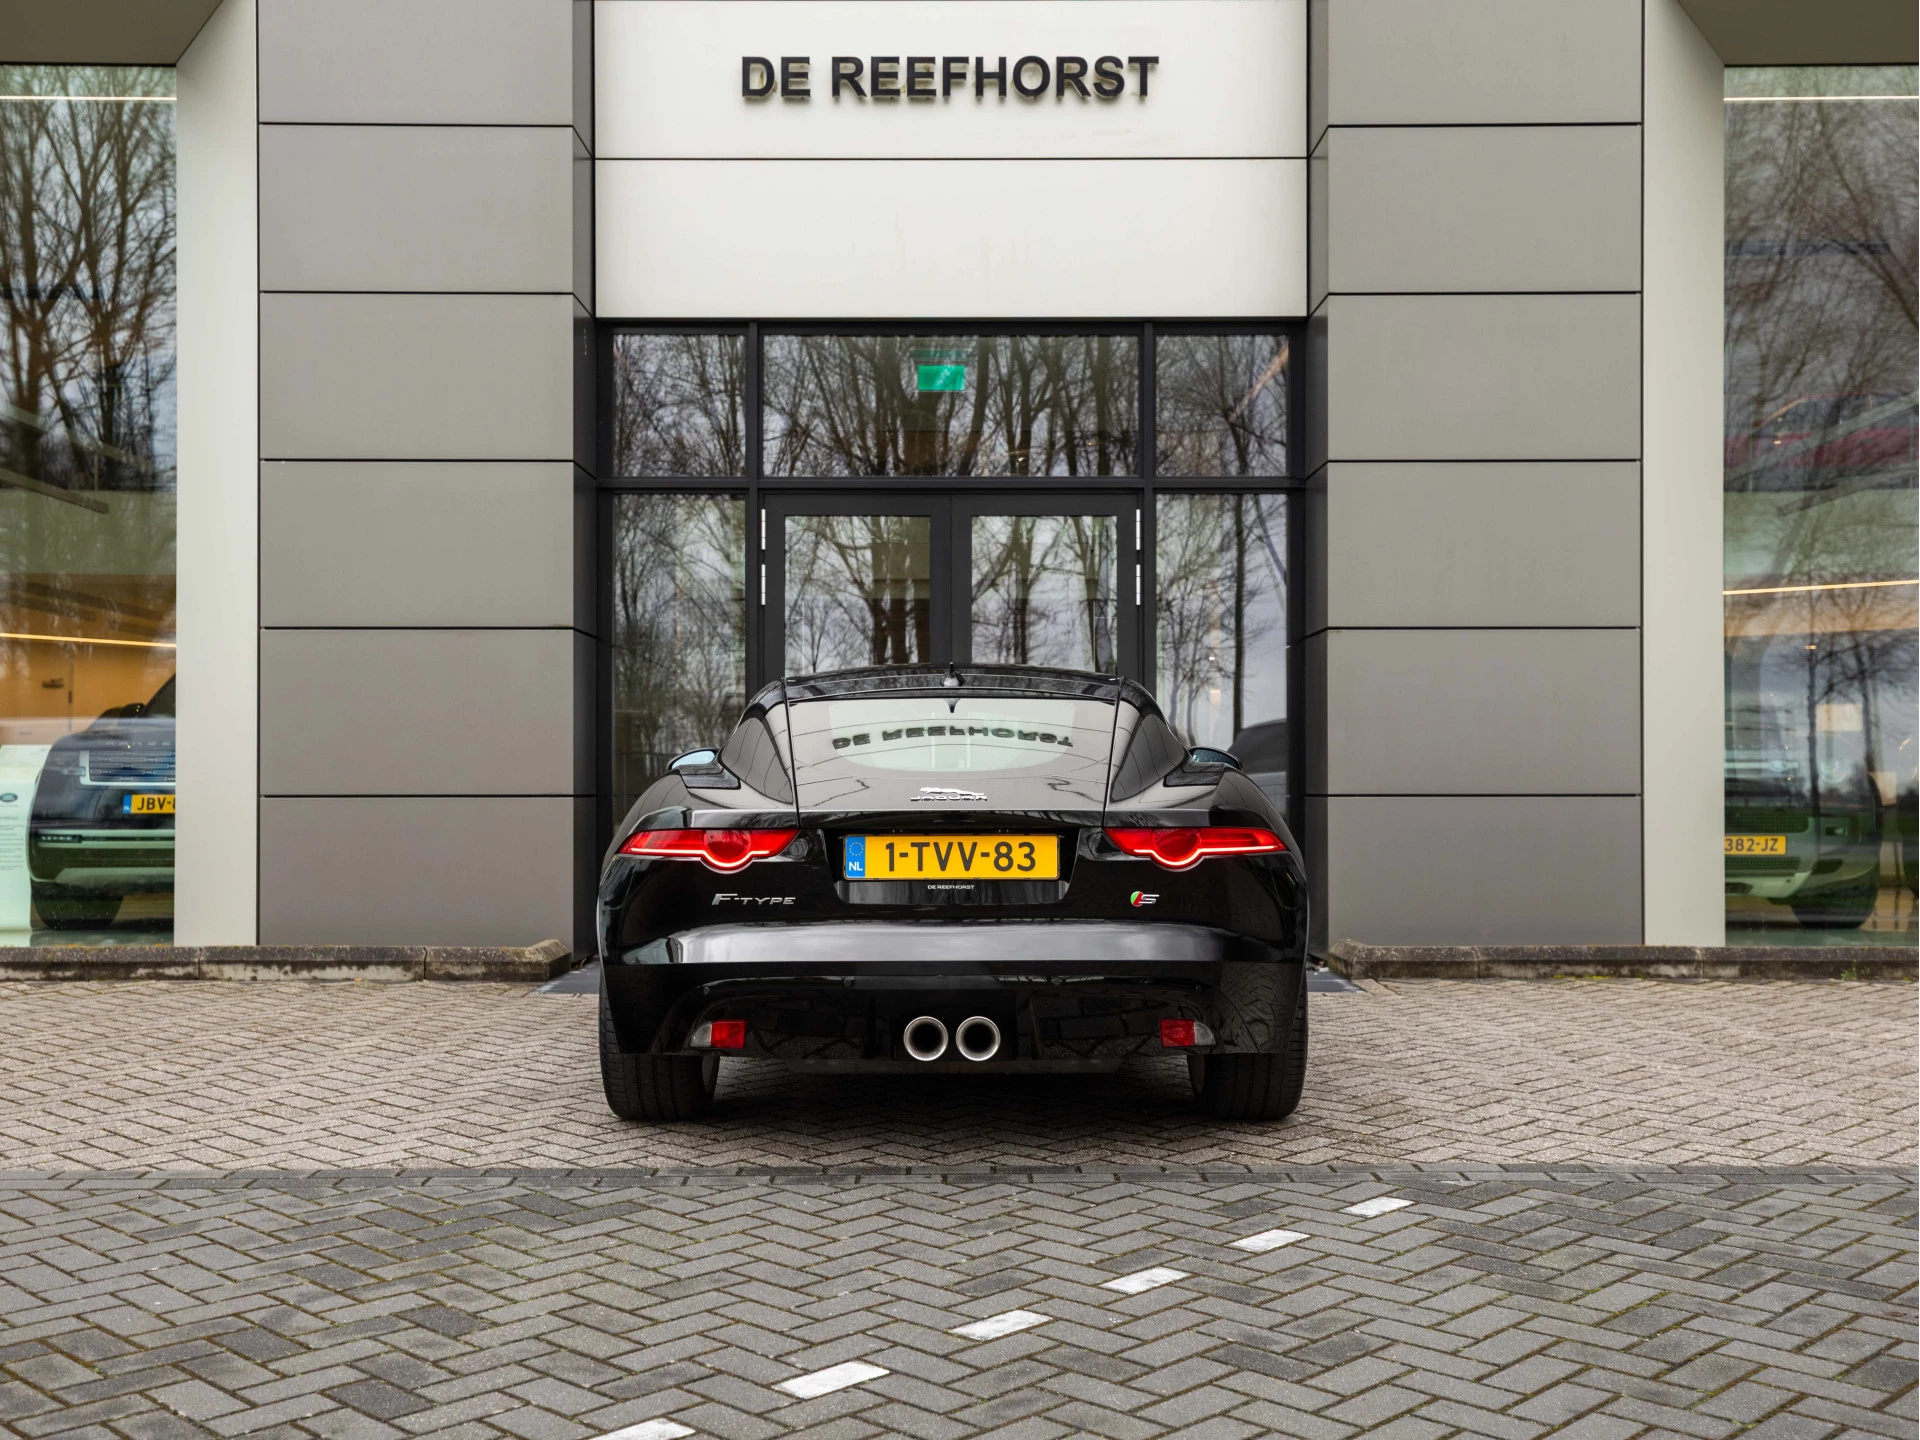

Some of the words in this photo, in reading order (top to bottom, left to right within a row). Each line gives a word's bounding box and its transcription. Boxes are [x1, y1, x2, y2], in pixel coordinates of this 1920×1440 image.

[741, 56, 811, 98] DE
[831, 55, 1160, 99] REEFHORST
[848, 861, 863, 871] NL
[885, 841, 1036, 872] 1-TVV-83
[711, 893, 796, 905] F-TYPE
